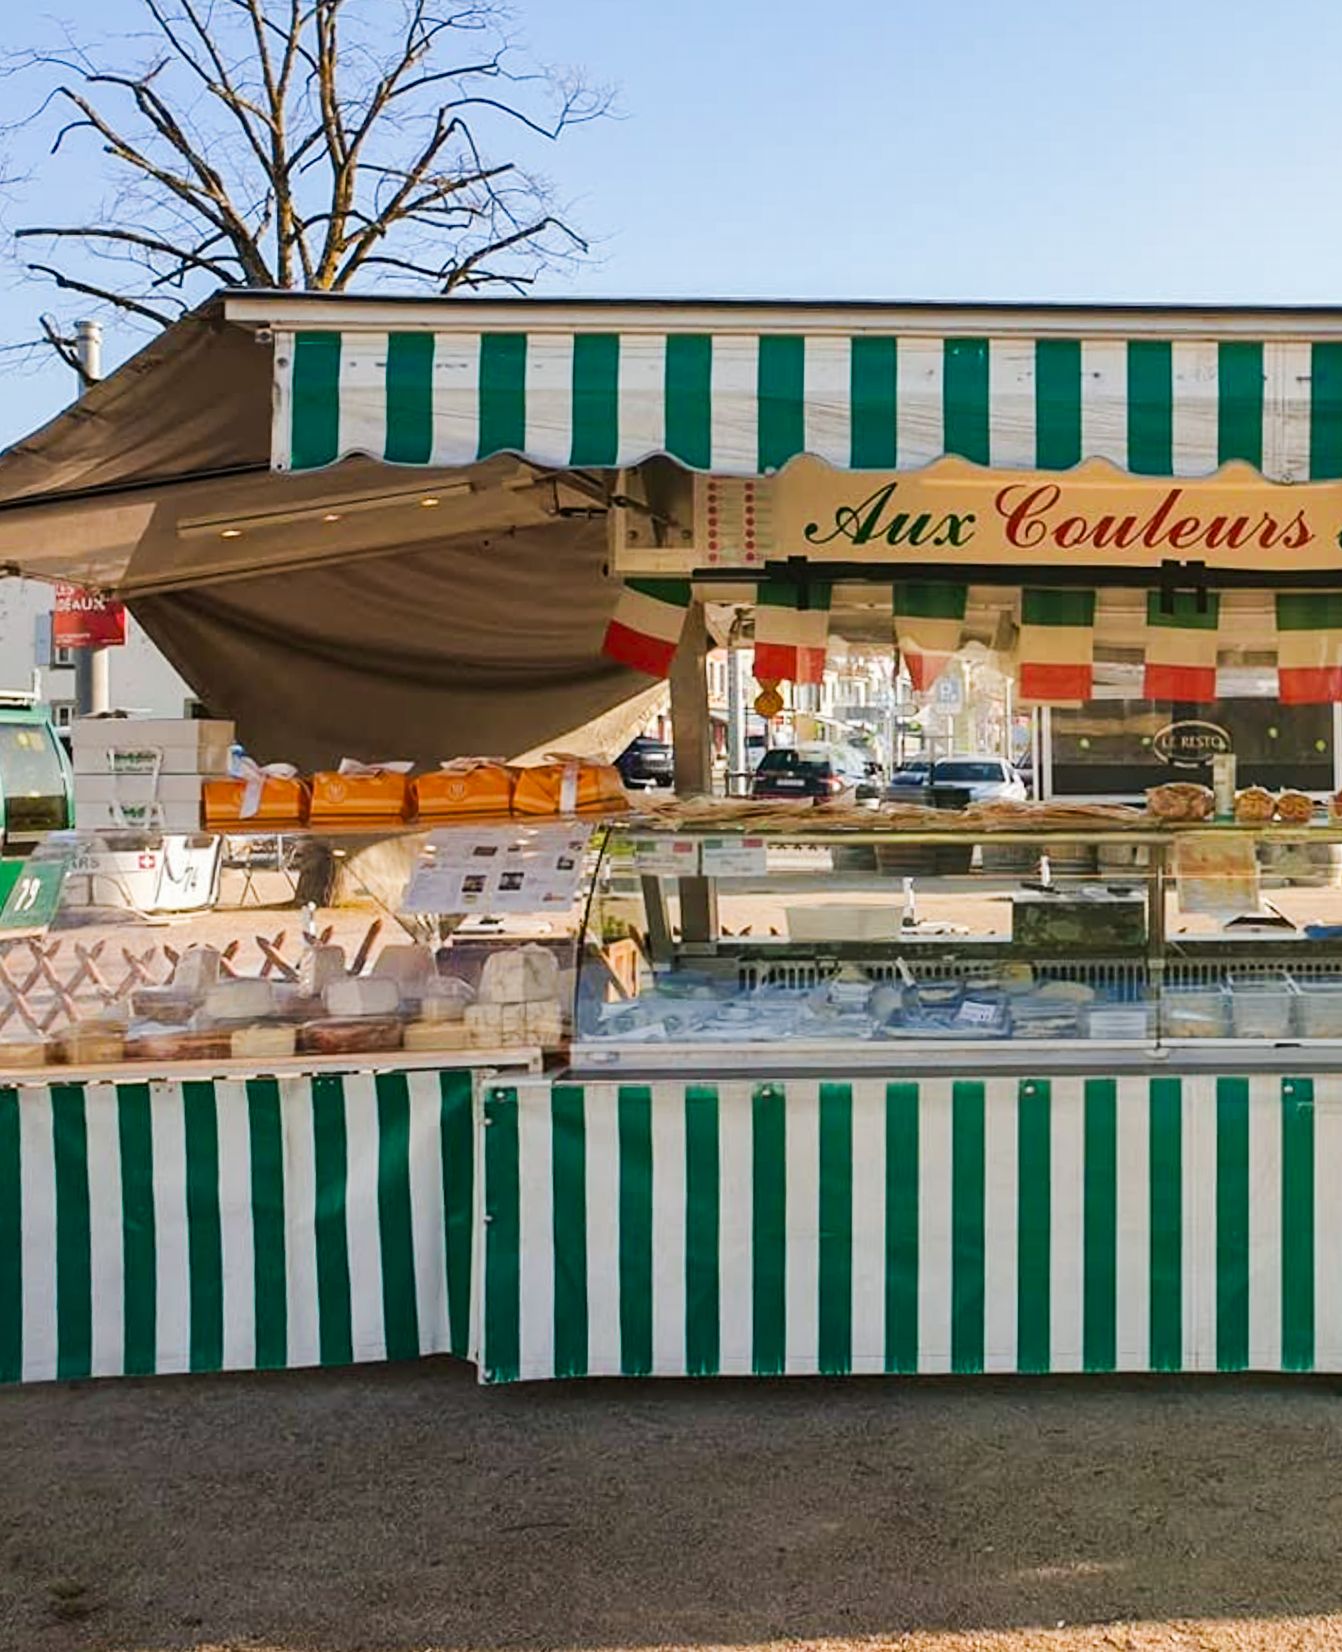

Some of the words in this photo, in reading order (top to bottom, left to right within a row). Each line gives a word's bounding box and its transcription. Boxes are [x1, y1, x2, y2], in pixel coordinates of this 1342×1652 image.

[803, 481, 977, 547] Aux
[994, 484, 1317, 550] Couleurs
[1181, 735, 1222, 749] RESTO
